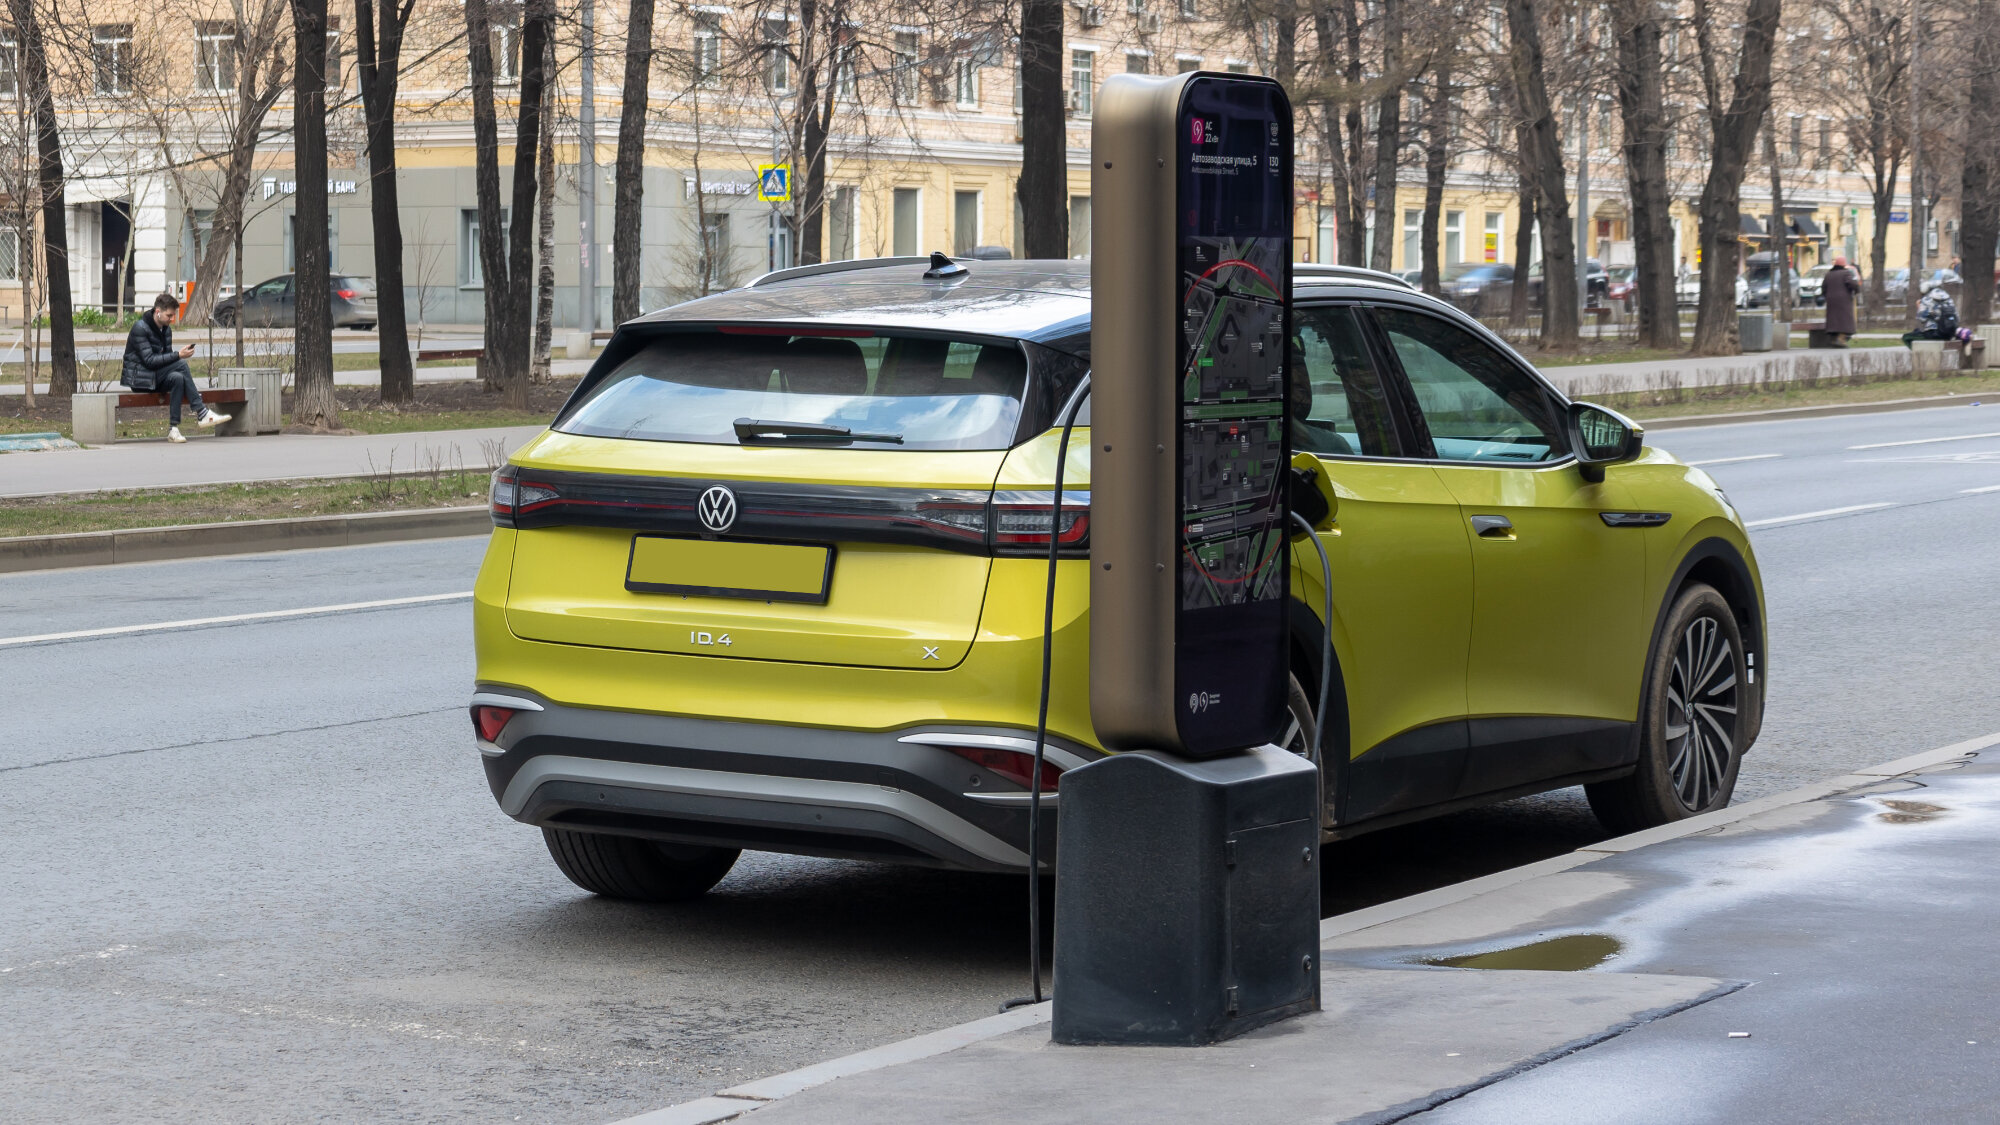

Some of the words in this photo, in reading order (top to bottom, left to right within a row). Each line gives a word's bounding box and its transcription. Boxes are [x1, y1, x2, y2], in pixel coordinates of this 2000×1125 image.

[1205, 121, 1212, 130] AC
[1205, 133, 1211, 142] 22
[1192, 153, 1233, 166] Автозаводская
[1252, 155, 1257, 166] 5
[1269, 156, 1279, 167] 130
[335, 181, 356, 194] БАНК
[922, 646, 940, 660] X
